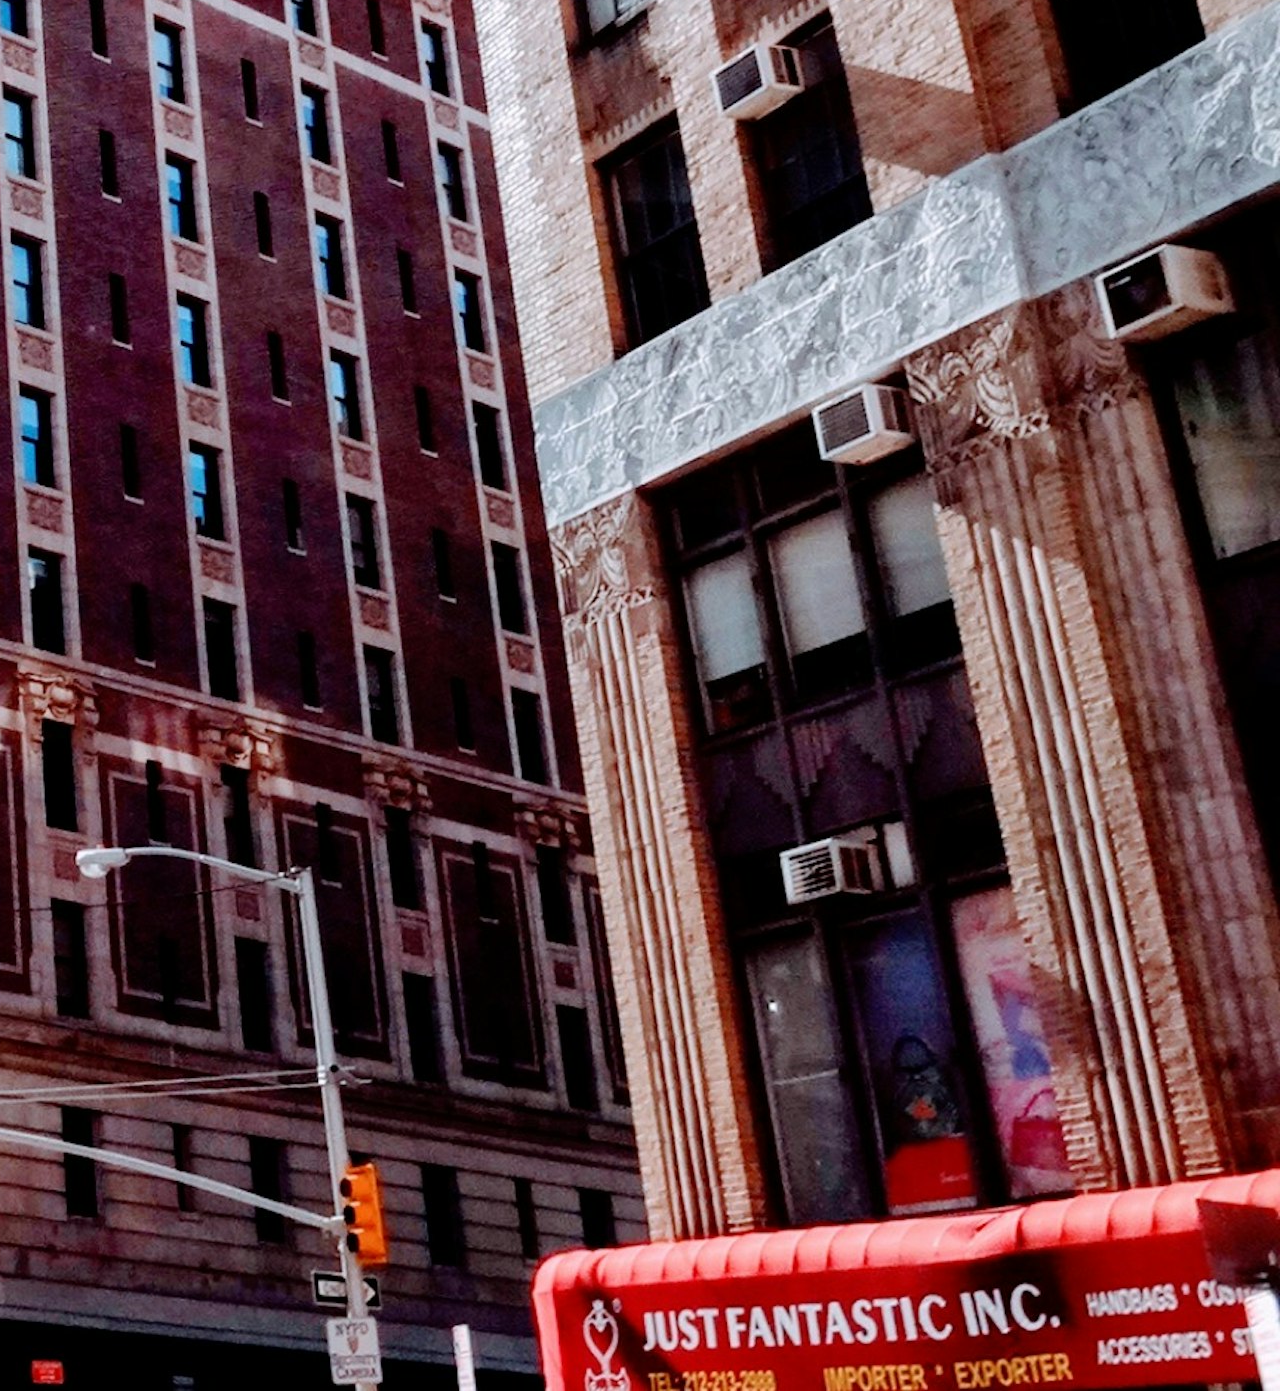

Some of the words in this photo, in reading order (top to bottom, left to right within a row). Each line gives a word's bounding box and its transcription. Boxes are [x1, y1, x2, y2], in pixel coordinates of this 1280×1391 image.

[643, 1308, 719, 1352] JUST
[725, 1294, 953, 1349] FANTASTIC
[959, 1283, 1061, 1337] INC.
[1085, 1283, 1178, 1317] HANDBAGS
[1097, 1331, 1214, 1365] ACCESSORIES
[823, 1363, 928, 1391] IMPORTER
[954, 1353, 1074, 1389] EXPORTER
